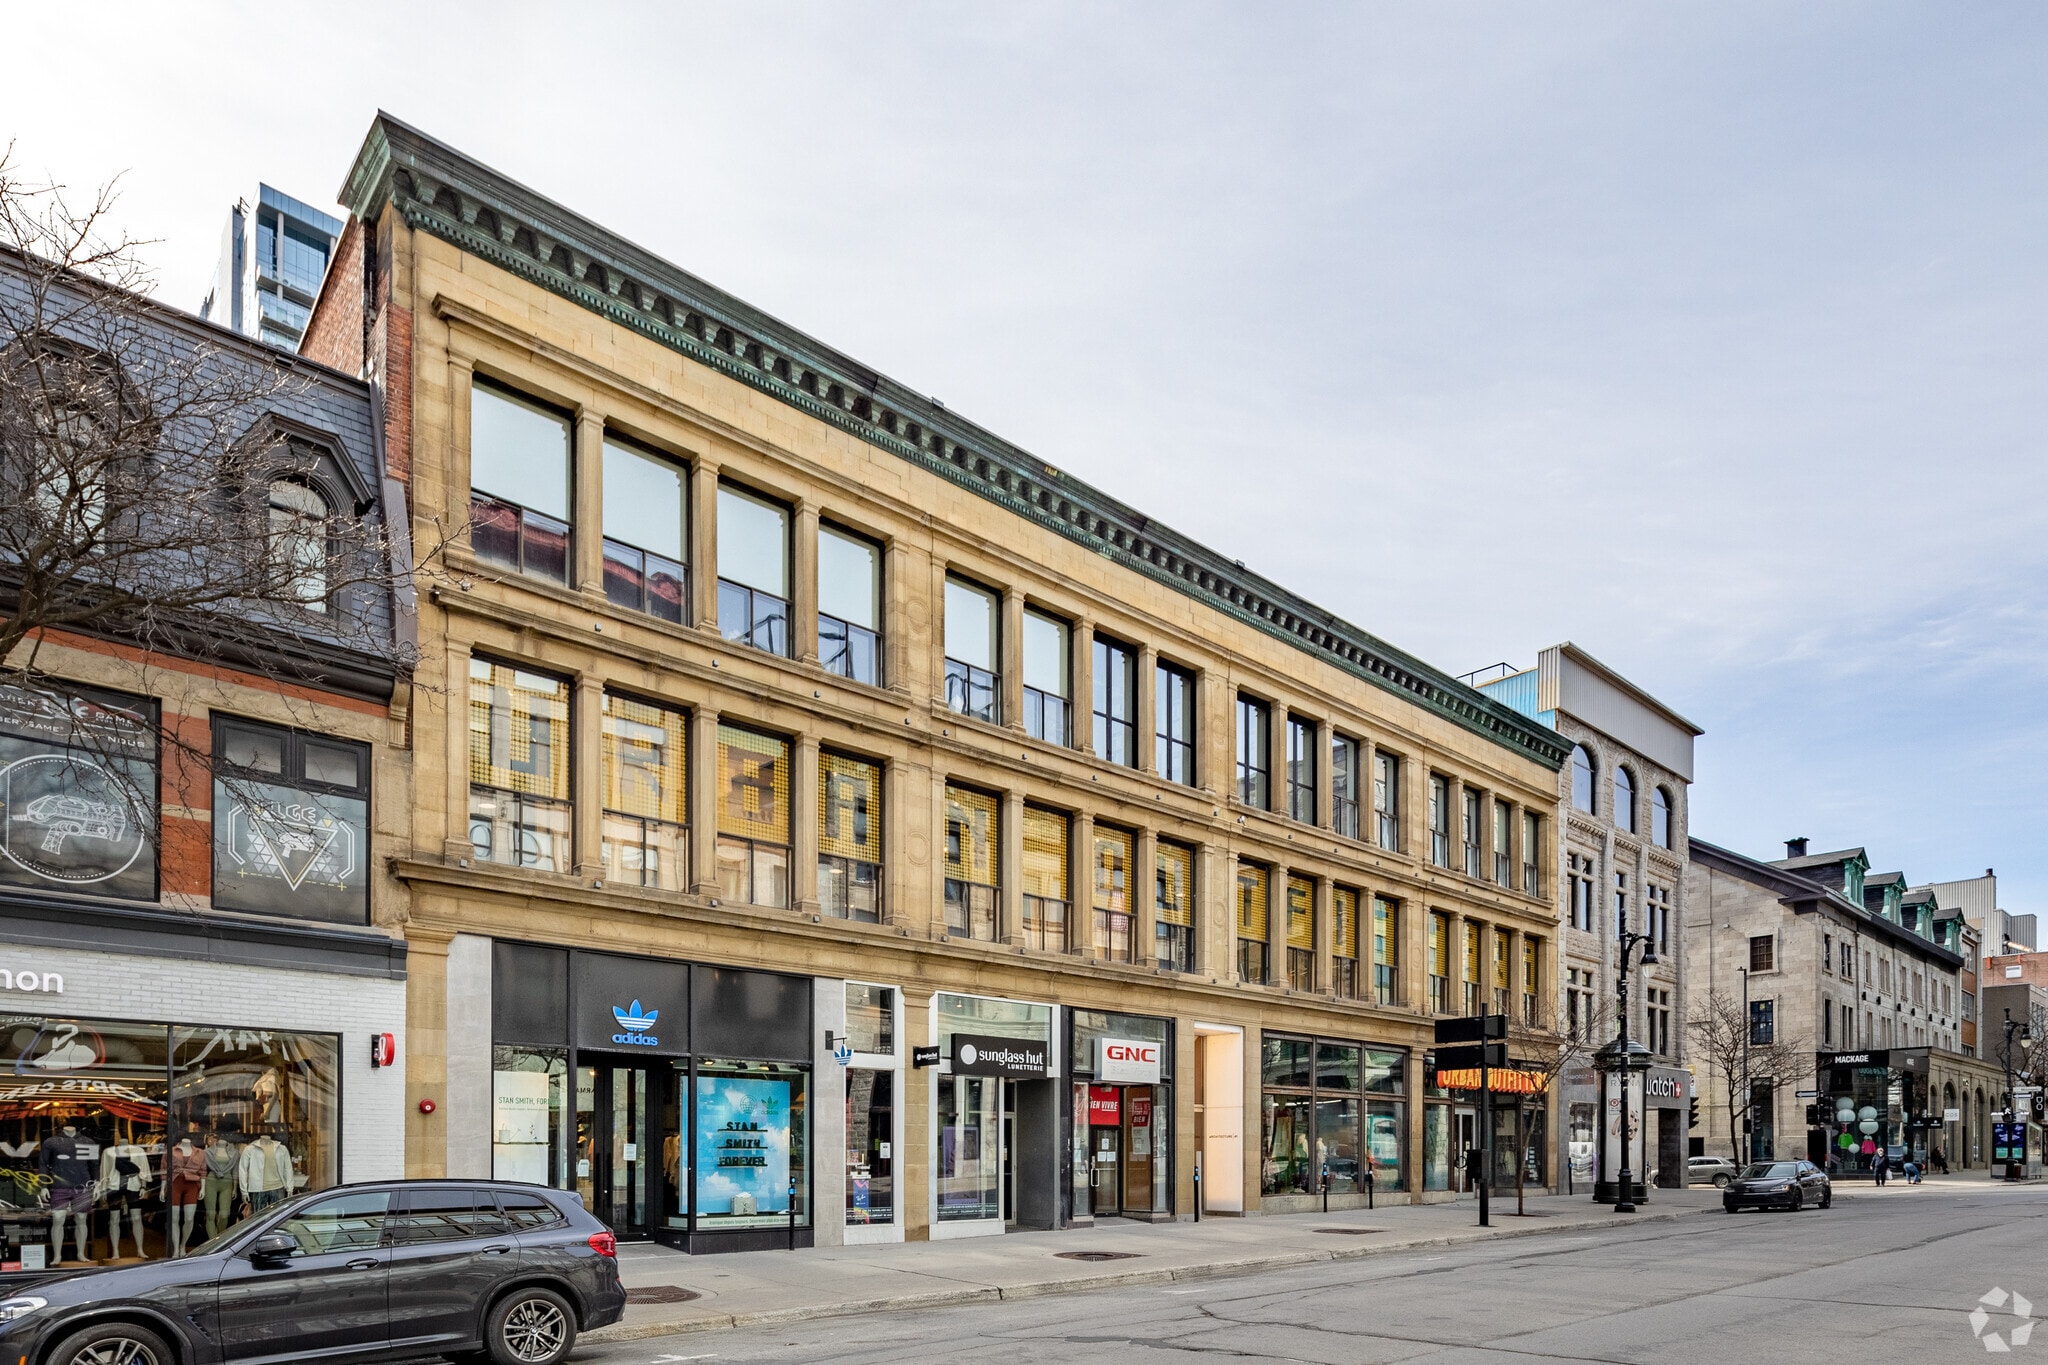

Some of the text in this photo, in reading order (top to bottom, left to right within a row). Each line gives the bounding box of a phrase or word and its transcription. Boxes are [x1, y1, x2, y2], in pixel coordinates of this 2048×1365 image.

[611, 1032, 659, 1046] adidas
[978, 1048, 1043, 1066] sunglass hut
[1106, 1045, 1156, 1063] GNC
[1835, 1054, 1870, 1064] MACKAGE
[1007, 1064, 1044, 1072] LUNETTERIE
[1442, 1068, 1481, 1087] URBAN
[498, 1096, 514, 1104] STAN
[515, 1097, 535, 1106] SMITH,
[1089, 1101, 1101, 1109] IEN
[1101, 1101, 1119, 1110] VIVRE
[726, 1121, 758, 1131] STAN
[725, 1138, 761, 1148] SMITH
[719, 1156, 766, 1166] FOREVER
